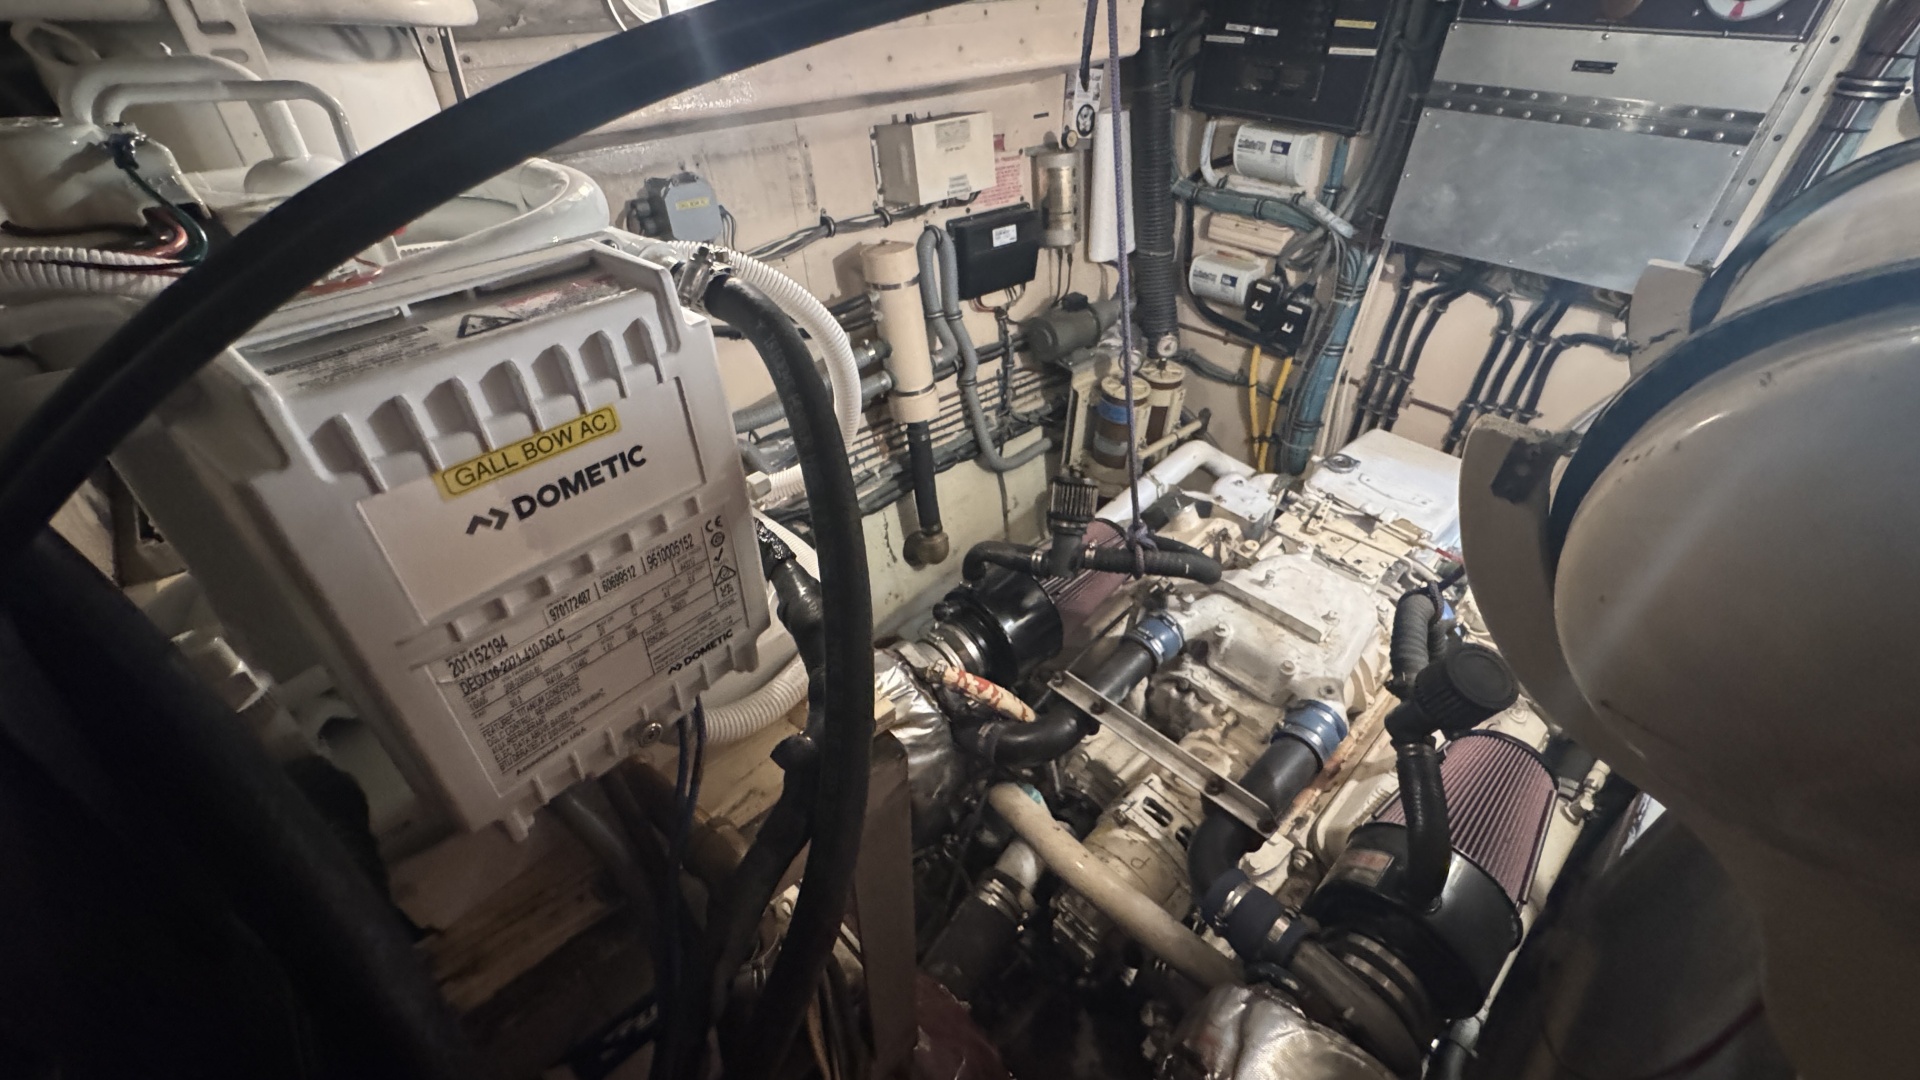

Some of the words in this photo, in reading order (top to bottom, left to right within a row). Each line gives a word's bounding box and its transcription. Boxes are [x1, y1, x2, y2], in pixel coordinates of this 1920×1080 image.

[455, 453, 518, 487] GALL
[521, 426, 573, 462] BOW
[580, 414, 608, 439] AC
[511, 445, 647, 521] DOMETIC
[448, 634, 508, 678] 201152194
[548, 588, 593, 622] 970172487
[645, 532, 695, 569] 9610005152
[538, 627, 566, 652] DGLC
[683, 628, 733, 666] DOMETIC
